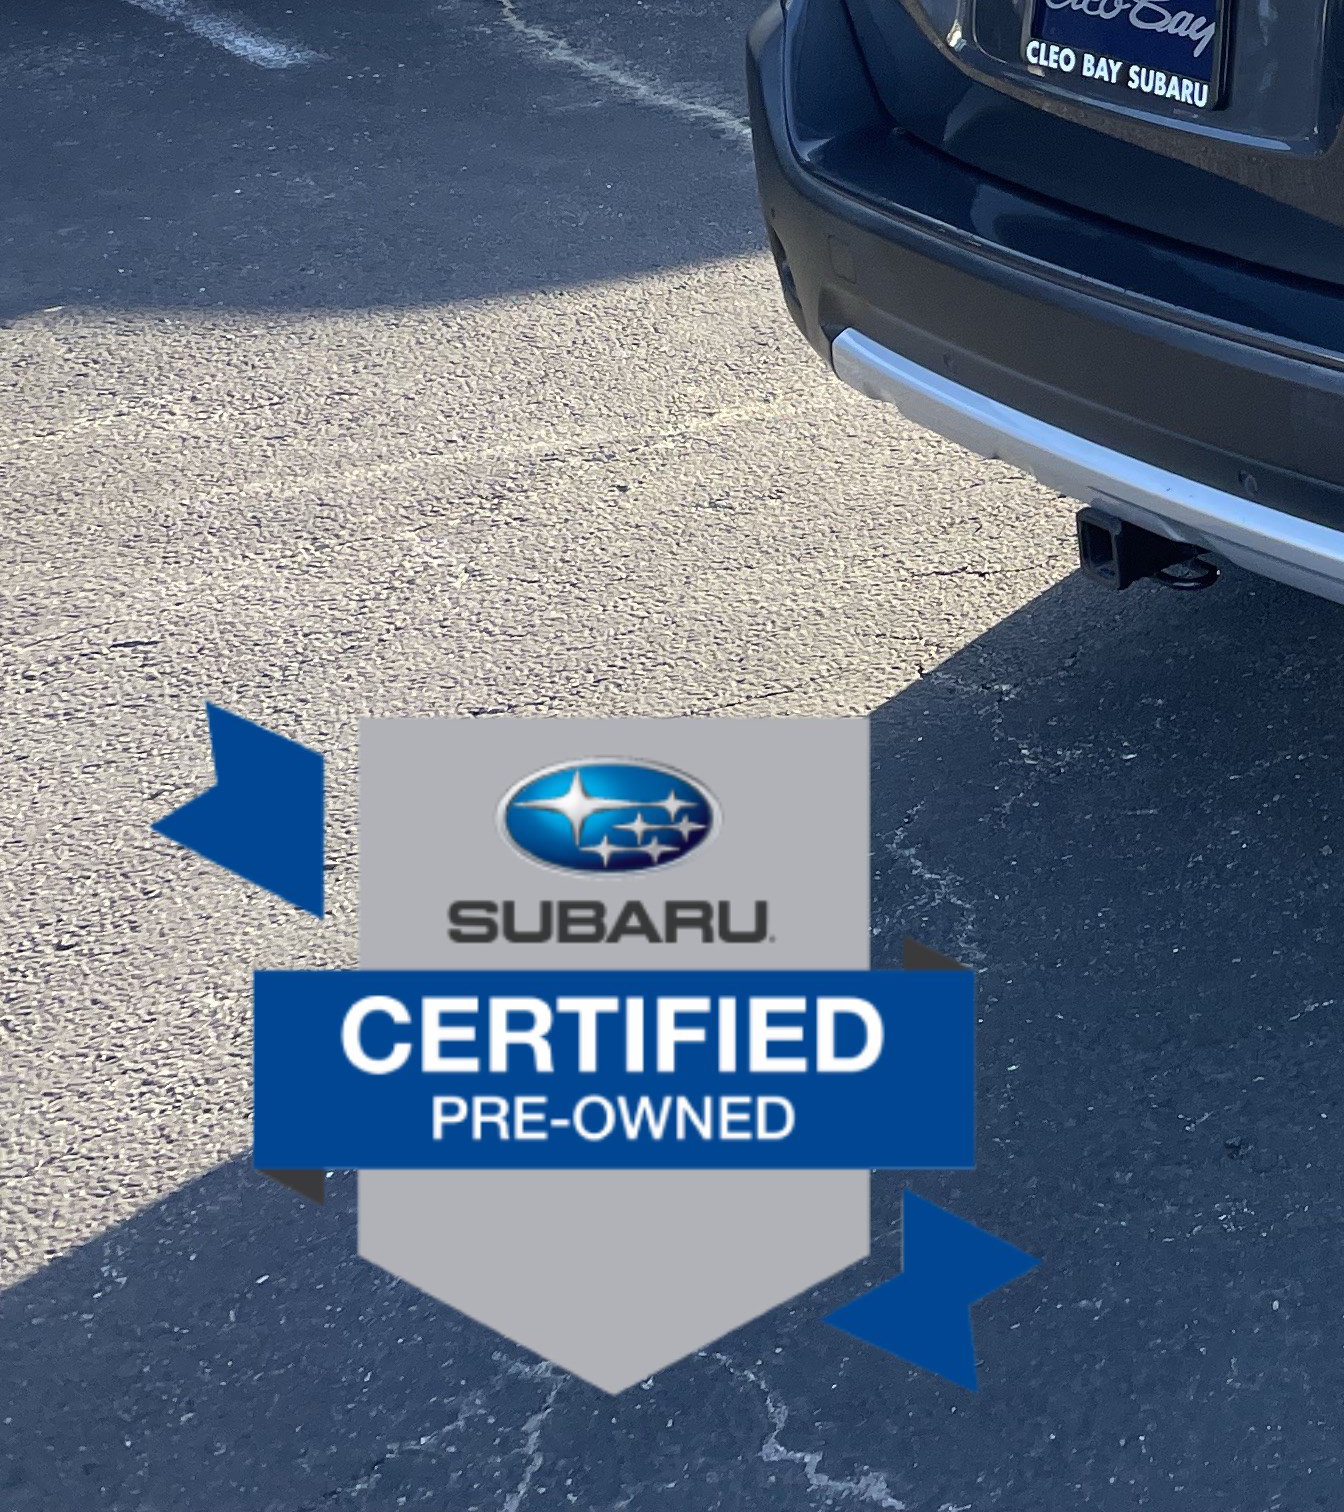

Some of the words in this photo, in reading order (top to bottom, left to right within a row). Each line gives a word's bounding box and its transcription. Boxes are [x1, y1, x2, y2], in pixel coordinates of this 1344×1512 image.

[1026, 40, 1076, 72] CLEO
[1082, 53, 1123, 84] BAY
[1127, 64, 1209, 108] SUBARU
